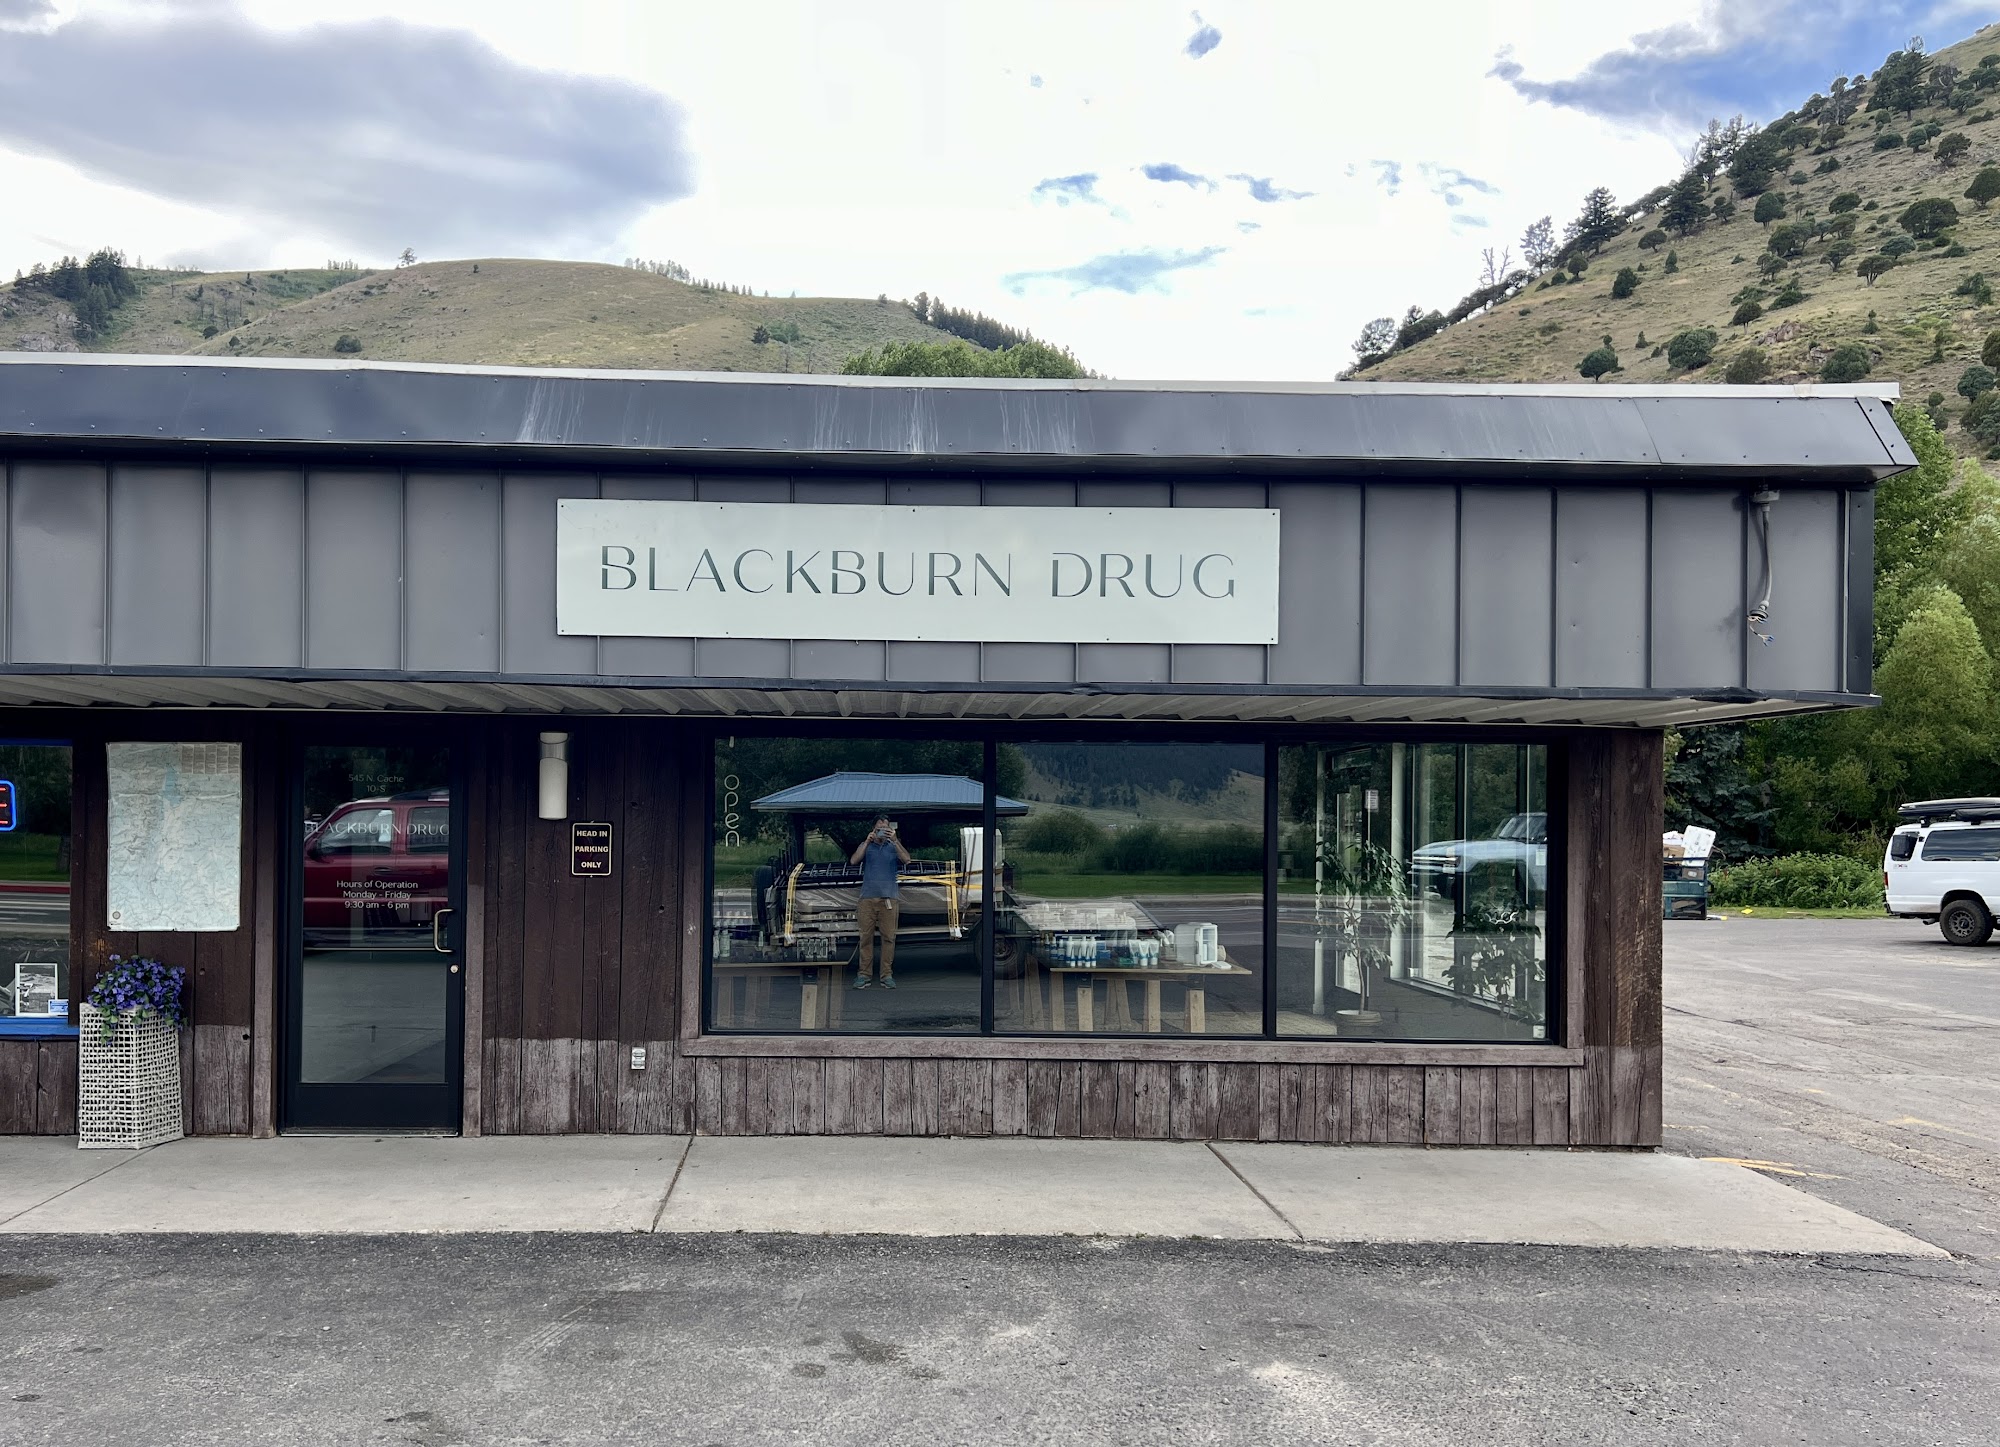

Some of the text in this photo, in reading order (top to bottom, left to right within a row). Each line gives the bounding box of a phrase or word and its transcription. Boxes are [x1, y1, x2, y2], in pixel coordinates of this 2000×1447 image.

[601, 545, 1235, 599] BLACKBURN DRUG
[348, 773, 365, 782] 545
[377, 774, 405, 783] Cache
[724, 774, 740, 847] open
[304, 822, 402, 835] BLACKBURN
[575, 845, 609, 853] PARKING
[336, 880, 419, 889] Hours of Operation
[343, 890, 377, 900] Monday
[384, 890, 411, 901] Friday
[344, 900, 364, 909] 9:30
[387, 900, 394, 909] 6
[395, 902, 410, 911] pm
